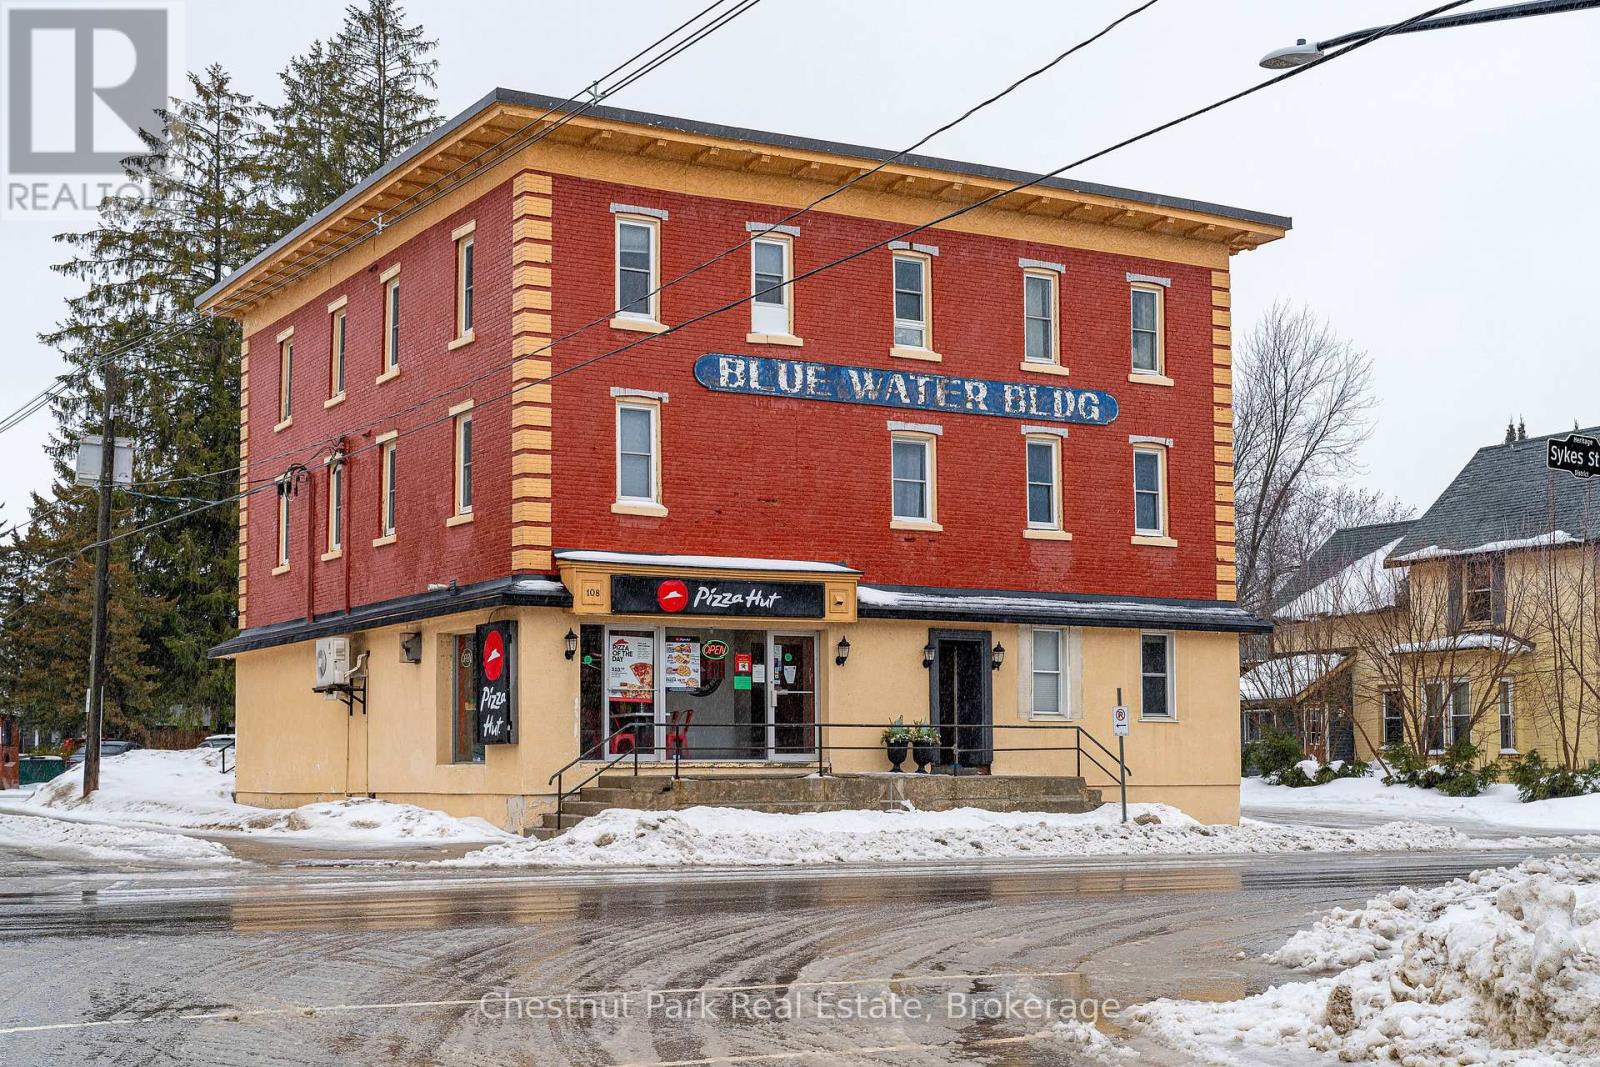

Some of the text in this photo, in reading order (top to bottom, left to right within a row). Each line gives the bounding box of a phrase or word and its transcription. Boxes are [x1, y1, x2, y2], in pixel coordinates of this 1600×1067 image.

[718, 357, 1101, 421] BLUE WATER BLDG
[1573, 437, 1593, 446] Heritage
[1550, 445, 1600, 467] Sykes St
[586, 588, 600, 597] 108
[693, 586, 782, 609] Pizza Hut
[703, 644, 727, 656] OPEN
[480, 686, 507, 713] Pizza
[483, 714, 504, 738] Hut
